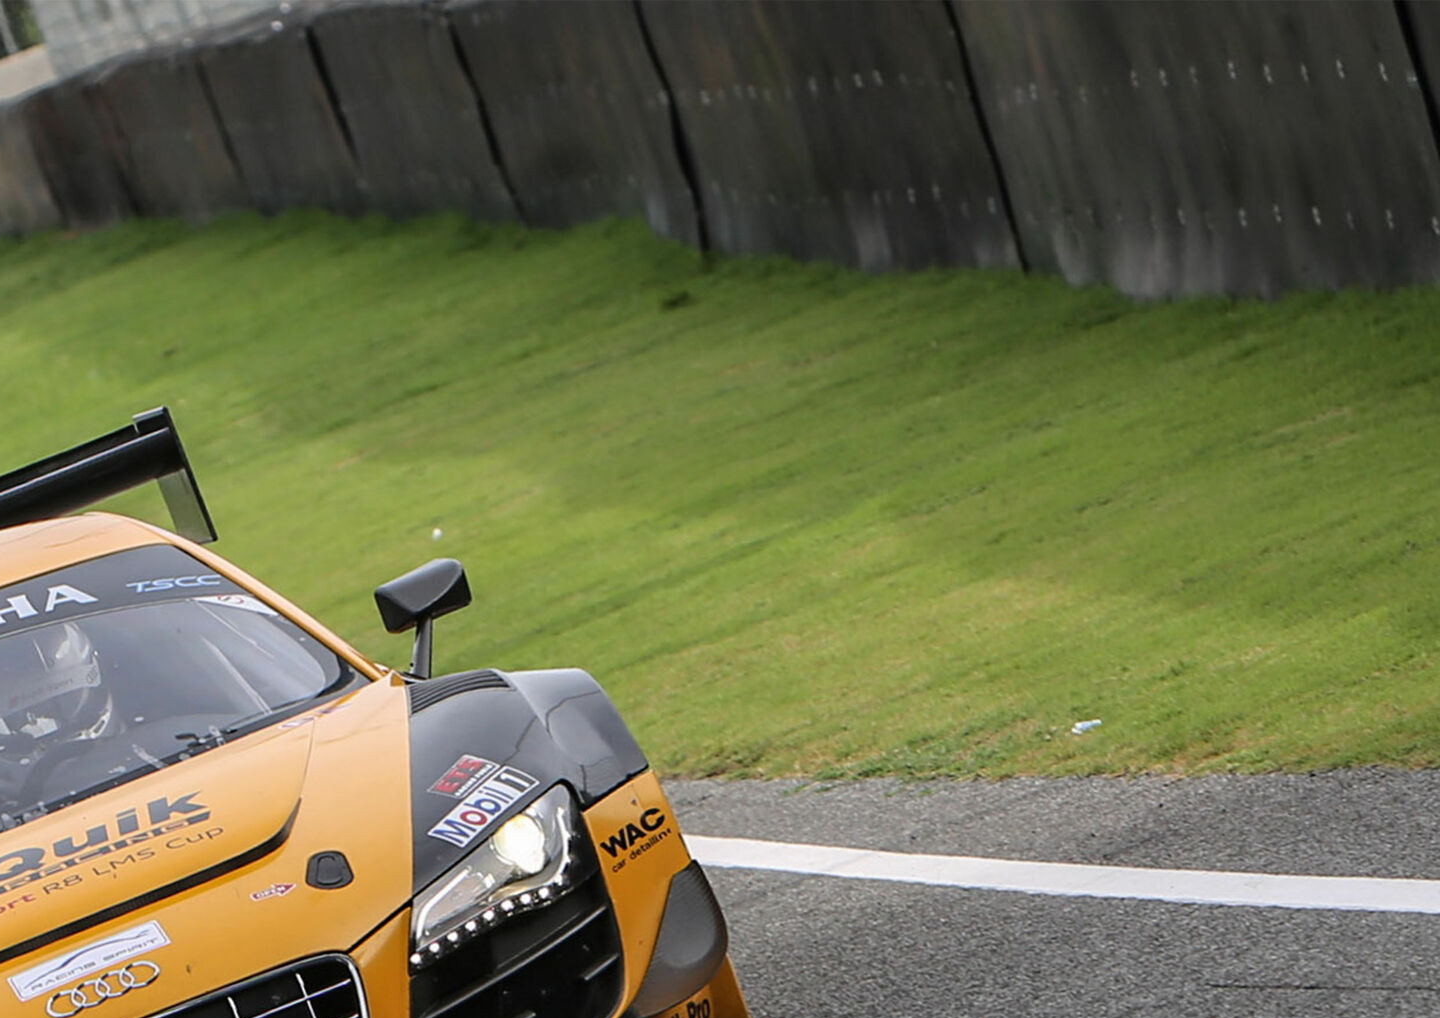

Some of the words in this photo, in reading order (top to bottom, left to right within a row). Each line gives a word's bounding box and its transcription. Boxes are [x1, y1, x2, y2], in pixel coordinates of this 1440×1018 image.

[125, 574, 222, 593] TSCC
[434, 757, 484, 793] ETS
[432, 785, 515, 845] Mobil
[500, 772, 531, 788] 1
[600, 807, 666, 858] WAC
[42, 874, 83, 895] R8
[92, 847, 156, 877] LMS
[165, 826, 224, 851] Cup
[611, 858, 627, 873] car
